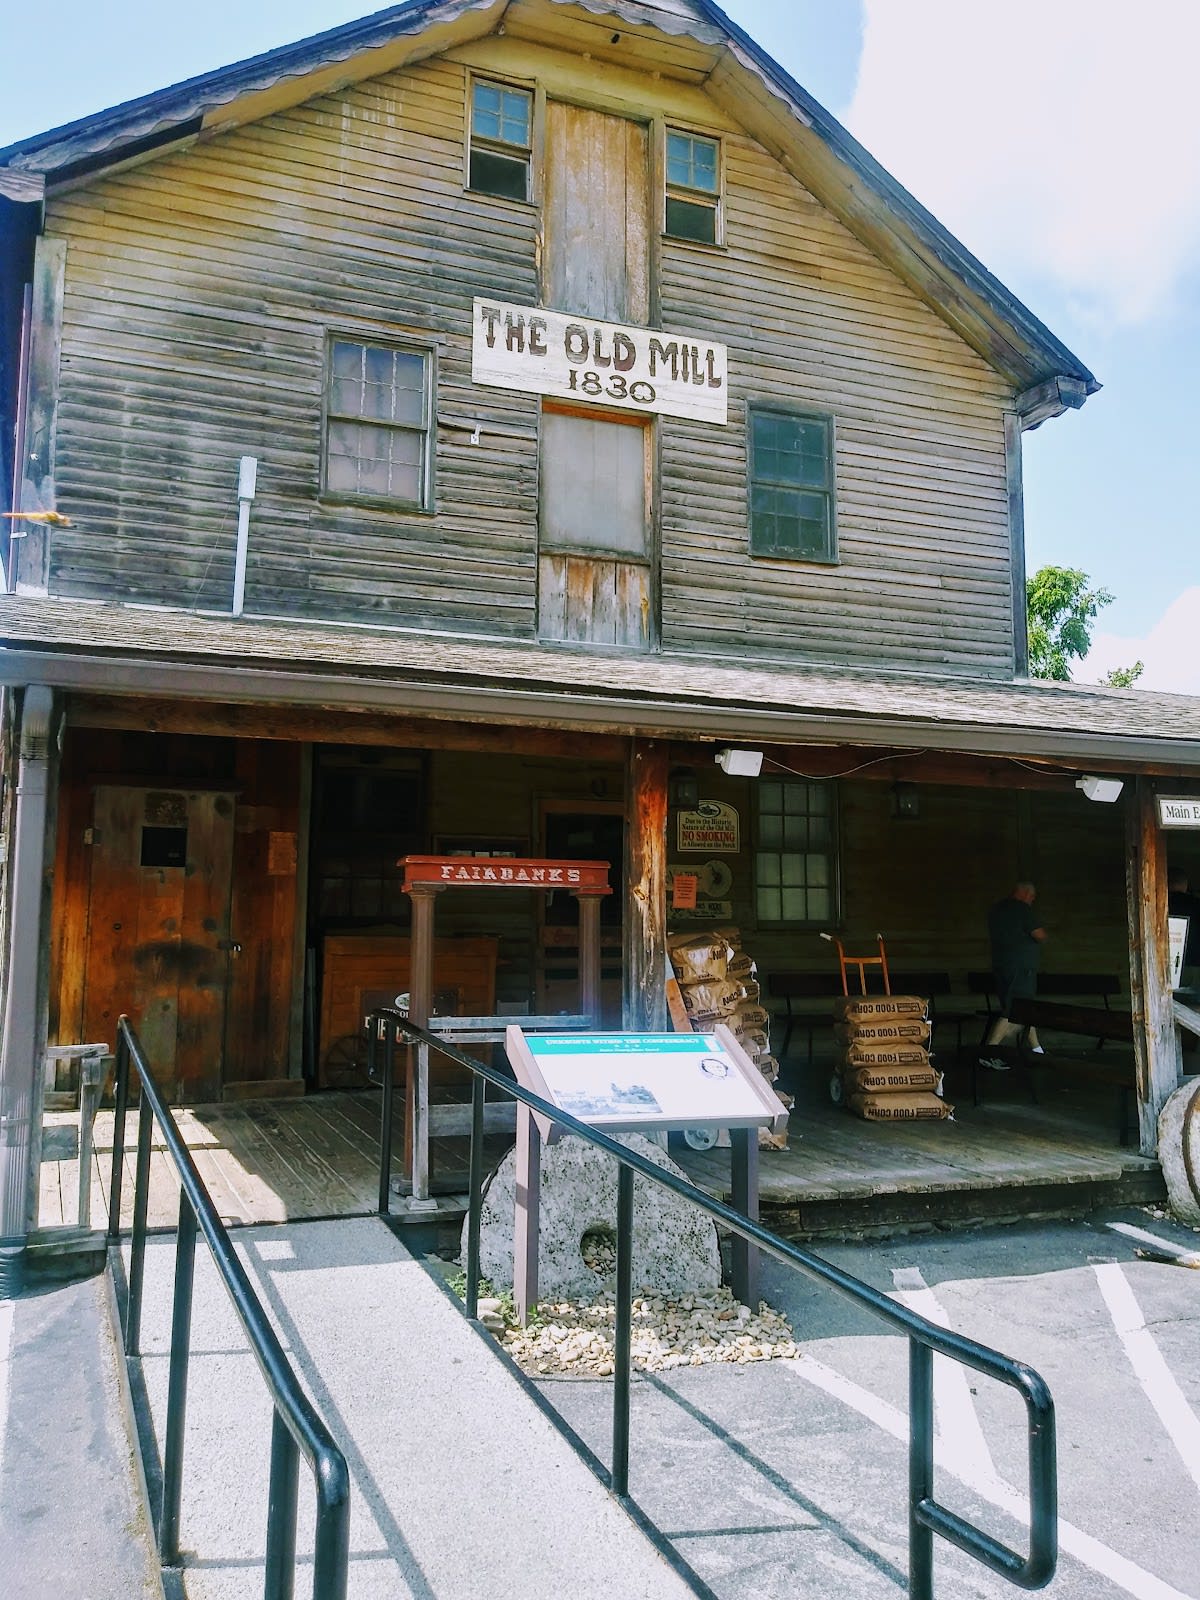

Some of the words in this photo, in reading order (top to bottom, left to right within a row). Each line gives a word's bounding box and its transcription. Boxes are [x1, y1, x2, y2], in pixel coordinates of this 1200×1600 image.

[481, 306, 548, 357] THE
[564, 323, 637, 372] OLD
[649, 338, 723, 388] MILL
[568, 369, 656, 404] 1830
[1166, 805, 1190, 819] Main
[682, 831, 694, 841] NO
[696, 831, 735, 842] SMOKING
[441, 865, 580, 881] FAIRBANKS
[876, 1003, 896, 1013] FOOD
[878, 1027, 898, 1037] FOOD
[878, 1053, 897, 1063] FOOD
[863, 1077, 886, 1086] CORN
[888, 1076, 909, 1085] FOOD
[893, 1108, 915, 1117] FOOD
